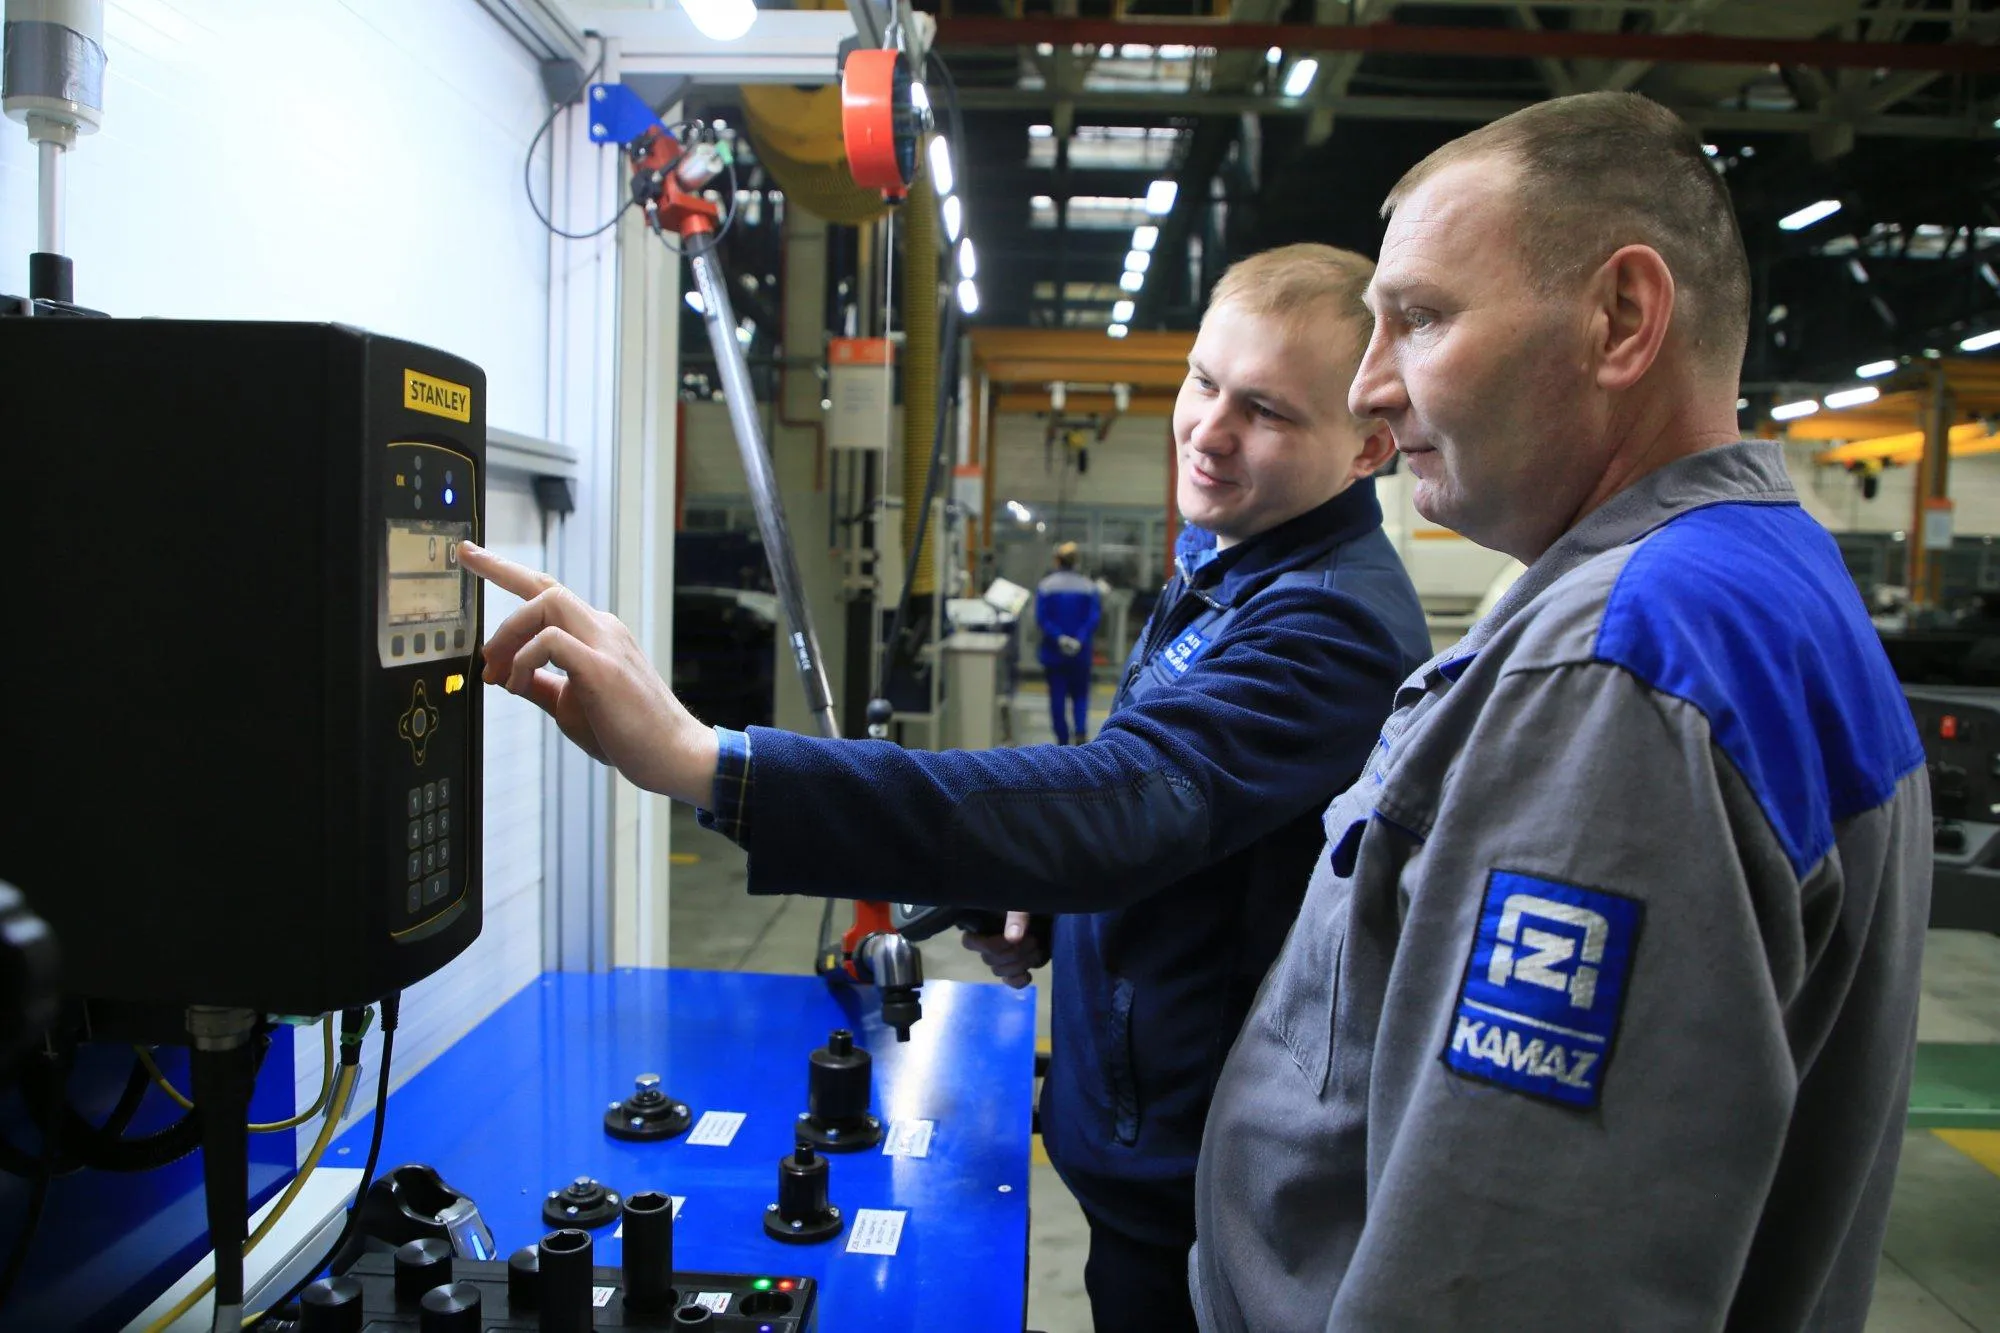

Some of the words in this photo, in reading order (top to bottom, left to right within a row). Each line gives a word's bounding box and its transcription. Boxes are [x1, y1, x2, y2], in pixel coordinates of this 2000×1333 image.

[411, 380, 467, 413] STANLEY
[427, 790, 433, 804] 2
[441, 786, 447, 798] 3
[412, 827, 419, 841] 4
[427, 822, 433, 835] 5
[441, 816, 447, 829] 6
[427, 853, 433, 866] 8
[441, 846, 447, 860] 9
[433, 880, 440, 893] 0
[1452, 1016, 1599, 1089] KAMAZ
